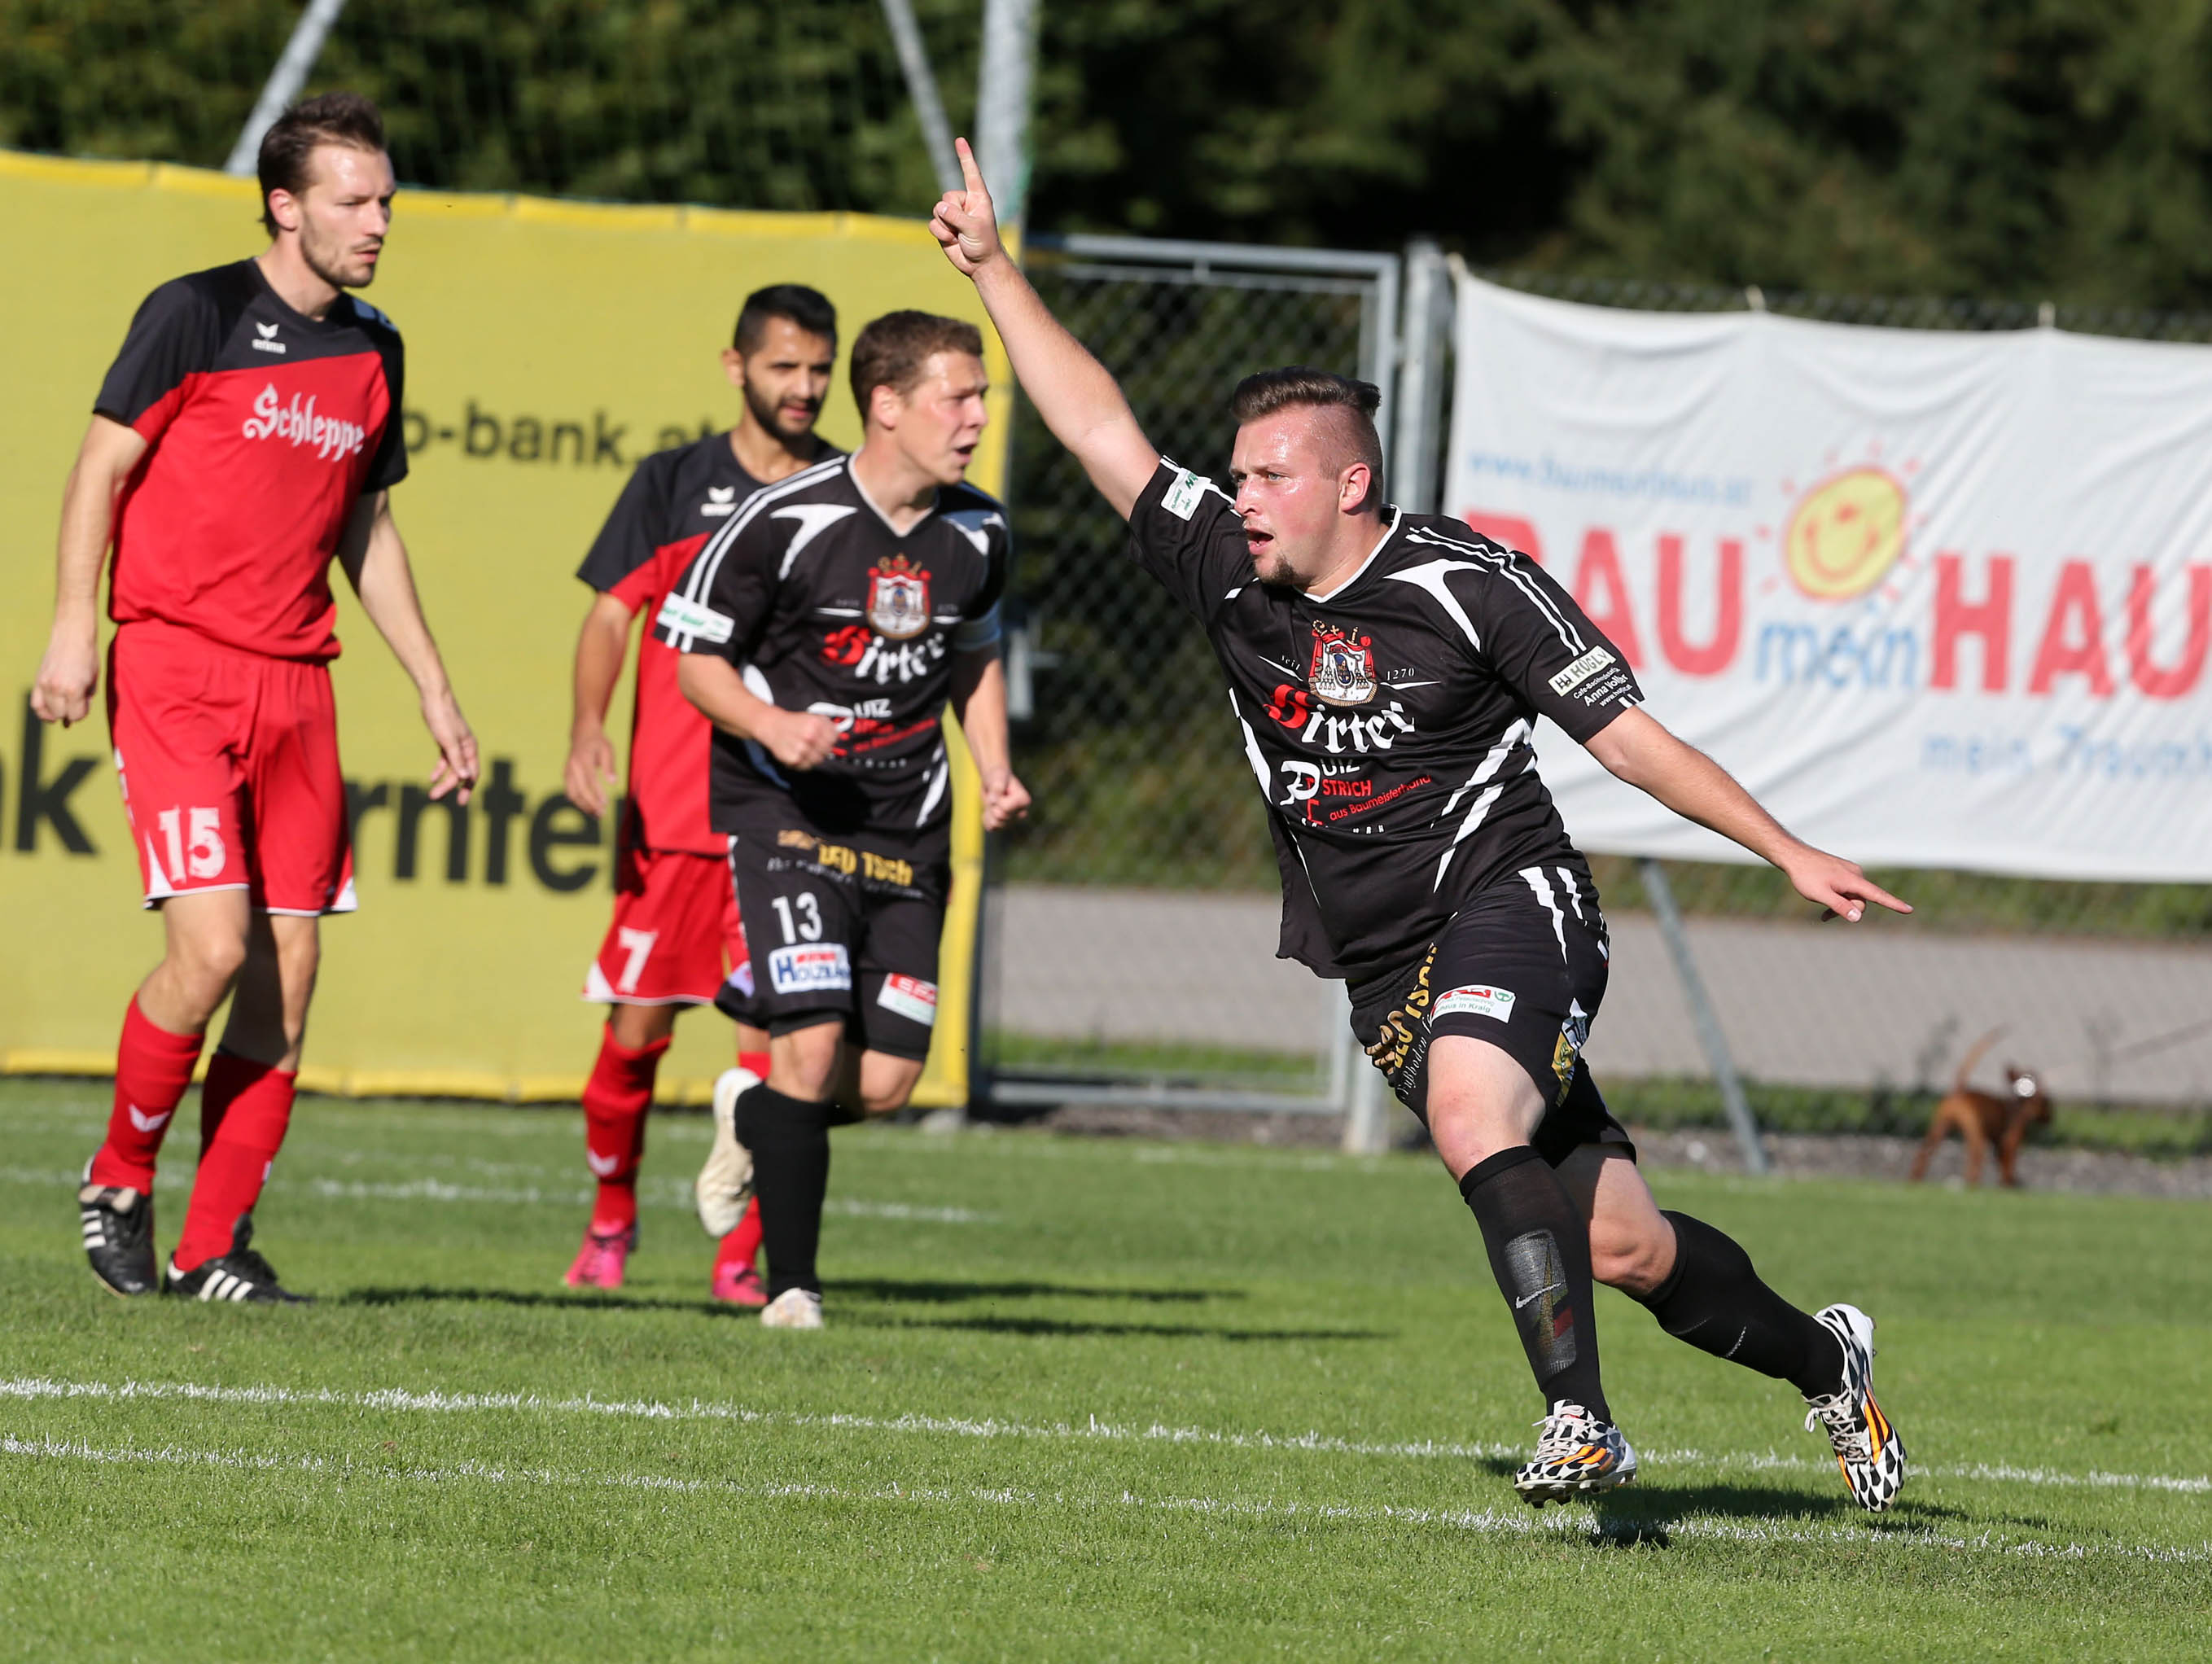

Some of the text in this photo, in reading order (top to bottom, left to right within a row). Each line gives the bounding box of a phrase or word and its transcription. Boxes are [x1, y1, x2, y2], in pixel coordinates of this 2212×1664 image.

[243, 382, 365, 462] Schleppe
[1386, 667, 1416, 681] 1270
[1583, 685, 1610, 707] Anna
[158, 804, 226, 884] 15
[771, 891, 823, 945] 13
[617, 926, 659, 995] 7
